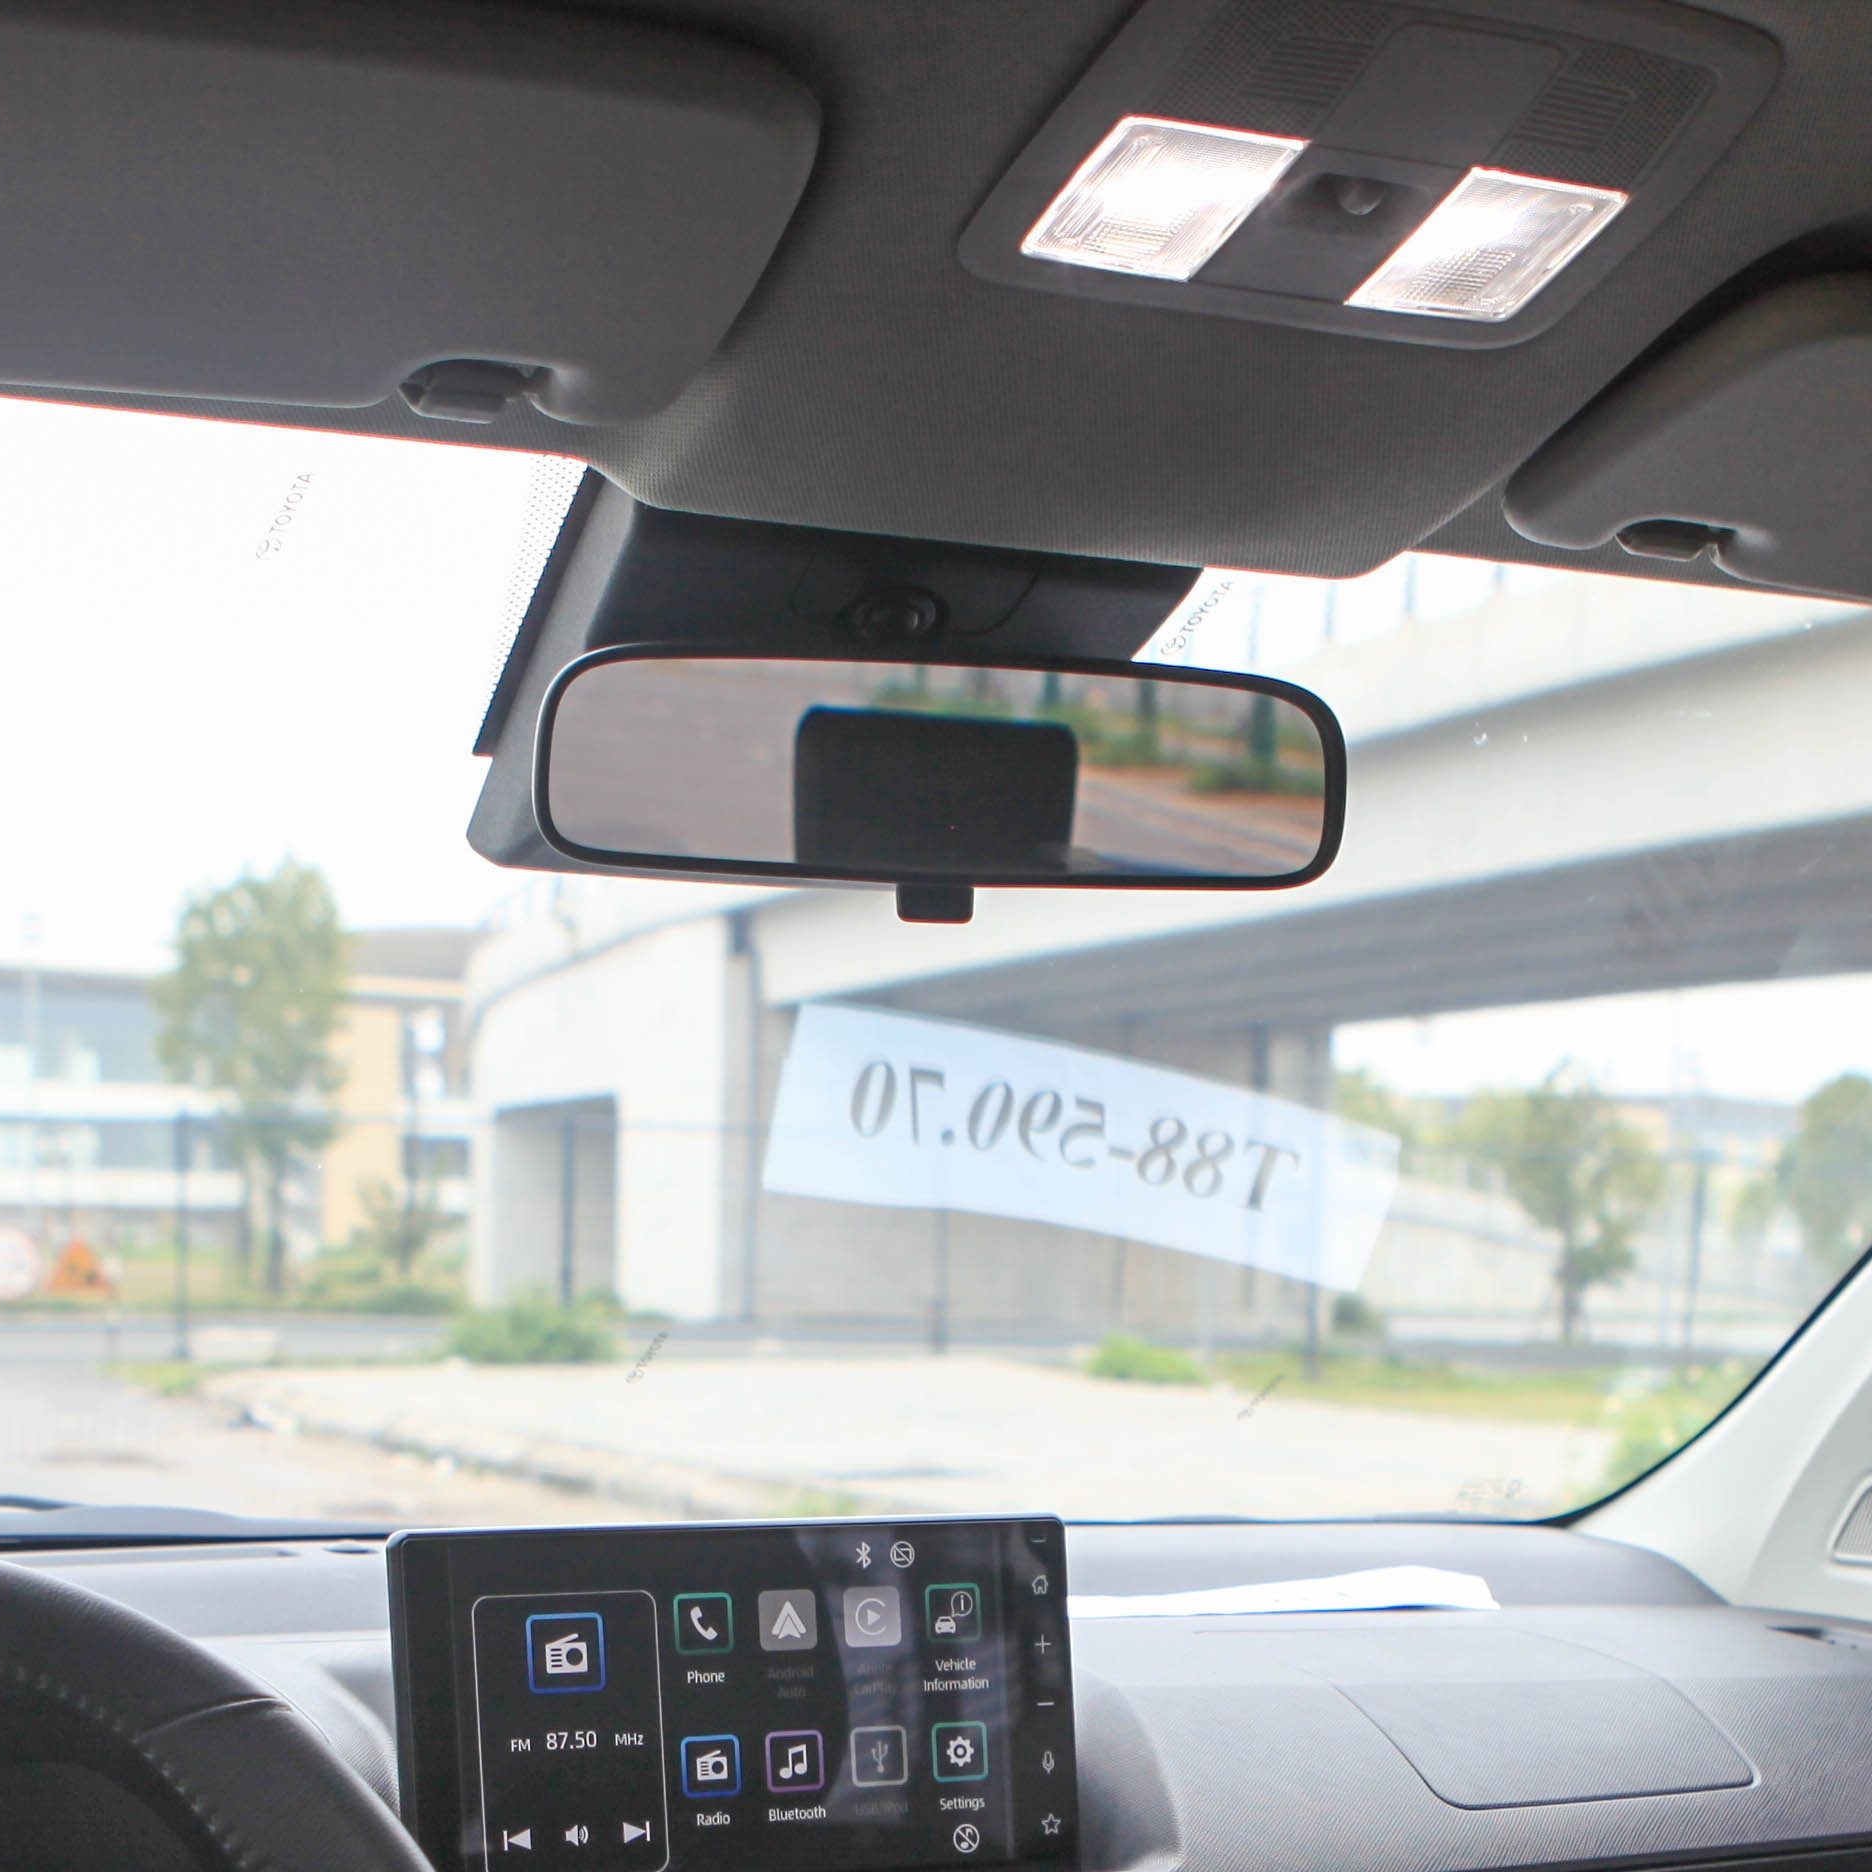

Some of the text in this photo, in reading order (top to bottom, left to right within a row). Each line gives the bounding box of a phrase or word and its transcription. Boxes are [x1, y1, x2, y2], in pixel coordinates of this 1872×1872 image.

[268, 471, 318, 535] TOYOTA
[1179, 581, 1234, 634] TOYOTA
[935, 1657, 977, 1672] Vehicle
[686, 1670, 726, 1684] Phone
[923, 1676, 990, 1692] Information
[510, 1730, 645, 1752] FM 87.50 MHz
[939, 1796, 986, 1811] Settings
[696, 1812, 731, 1827] Radio
[768, 1805, 827, 1822] Bluetooth
